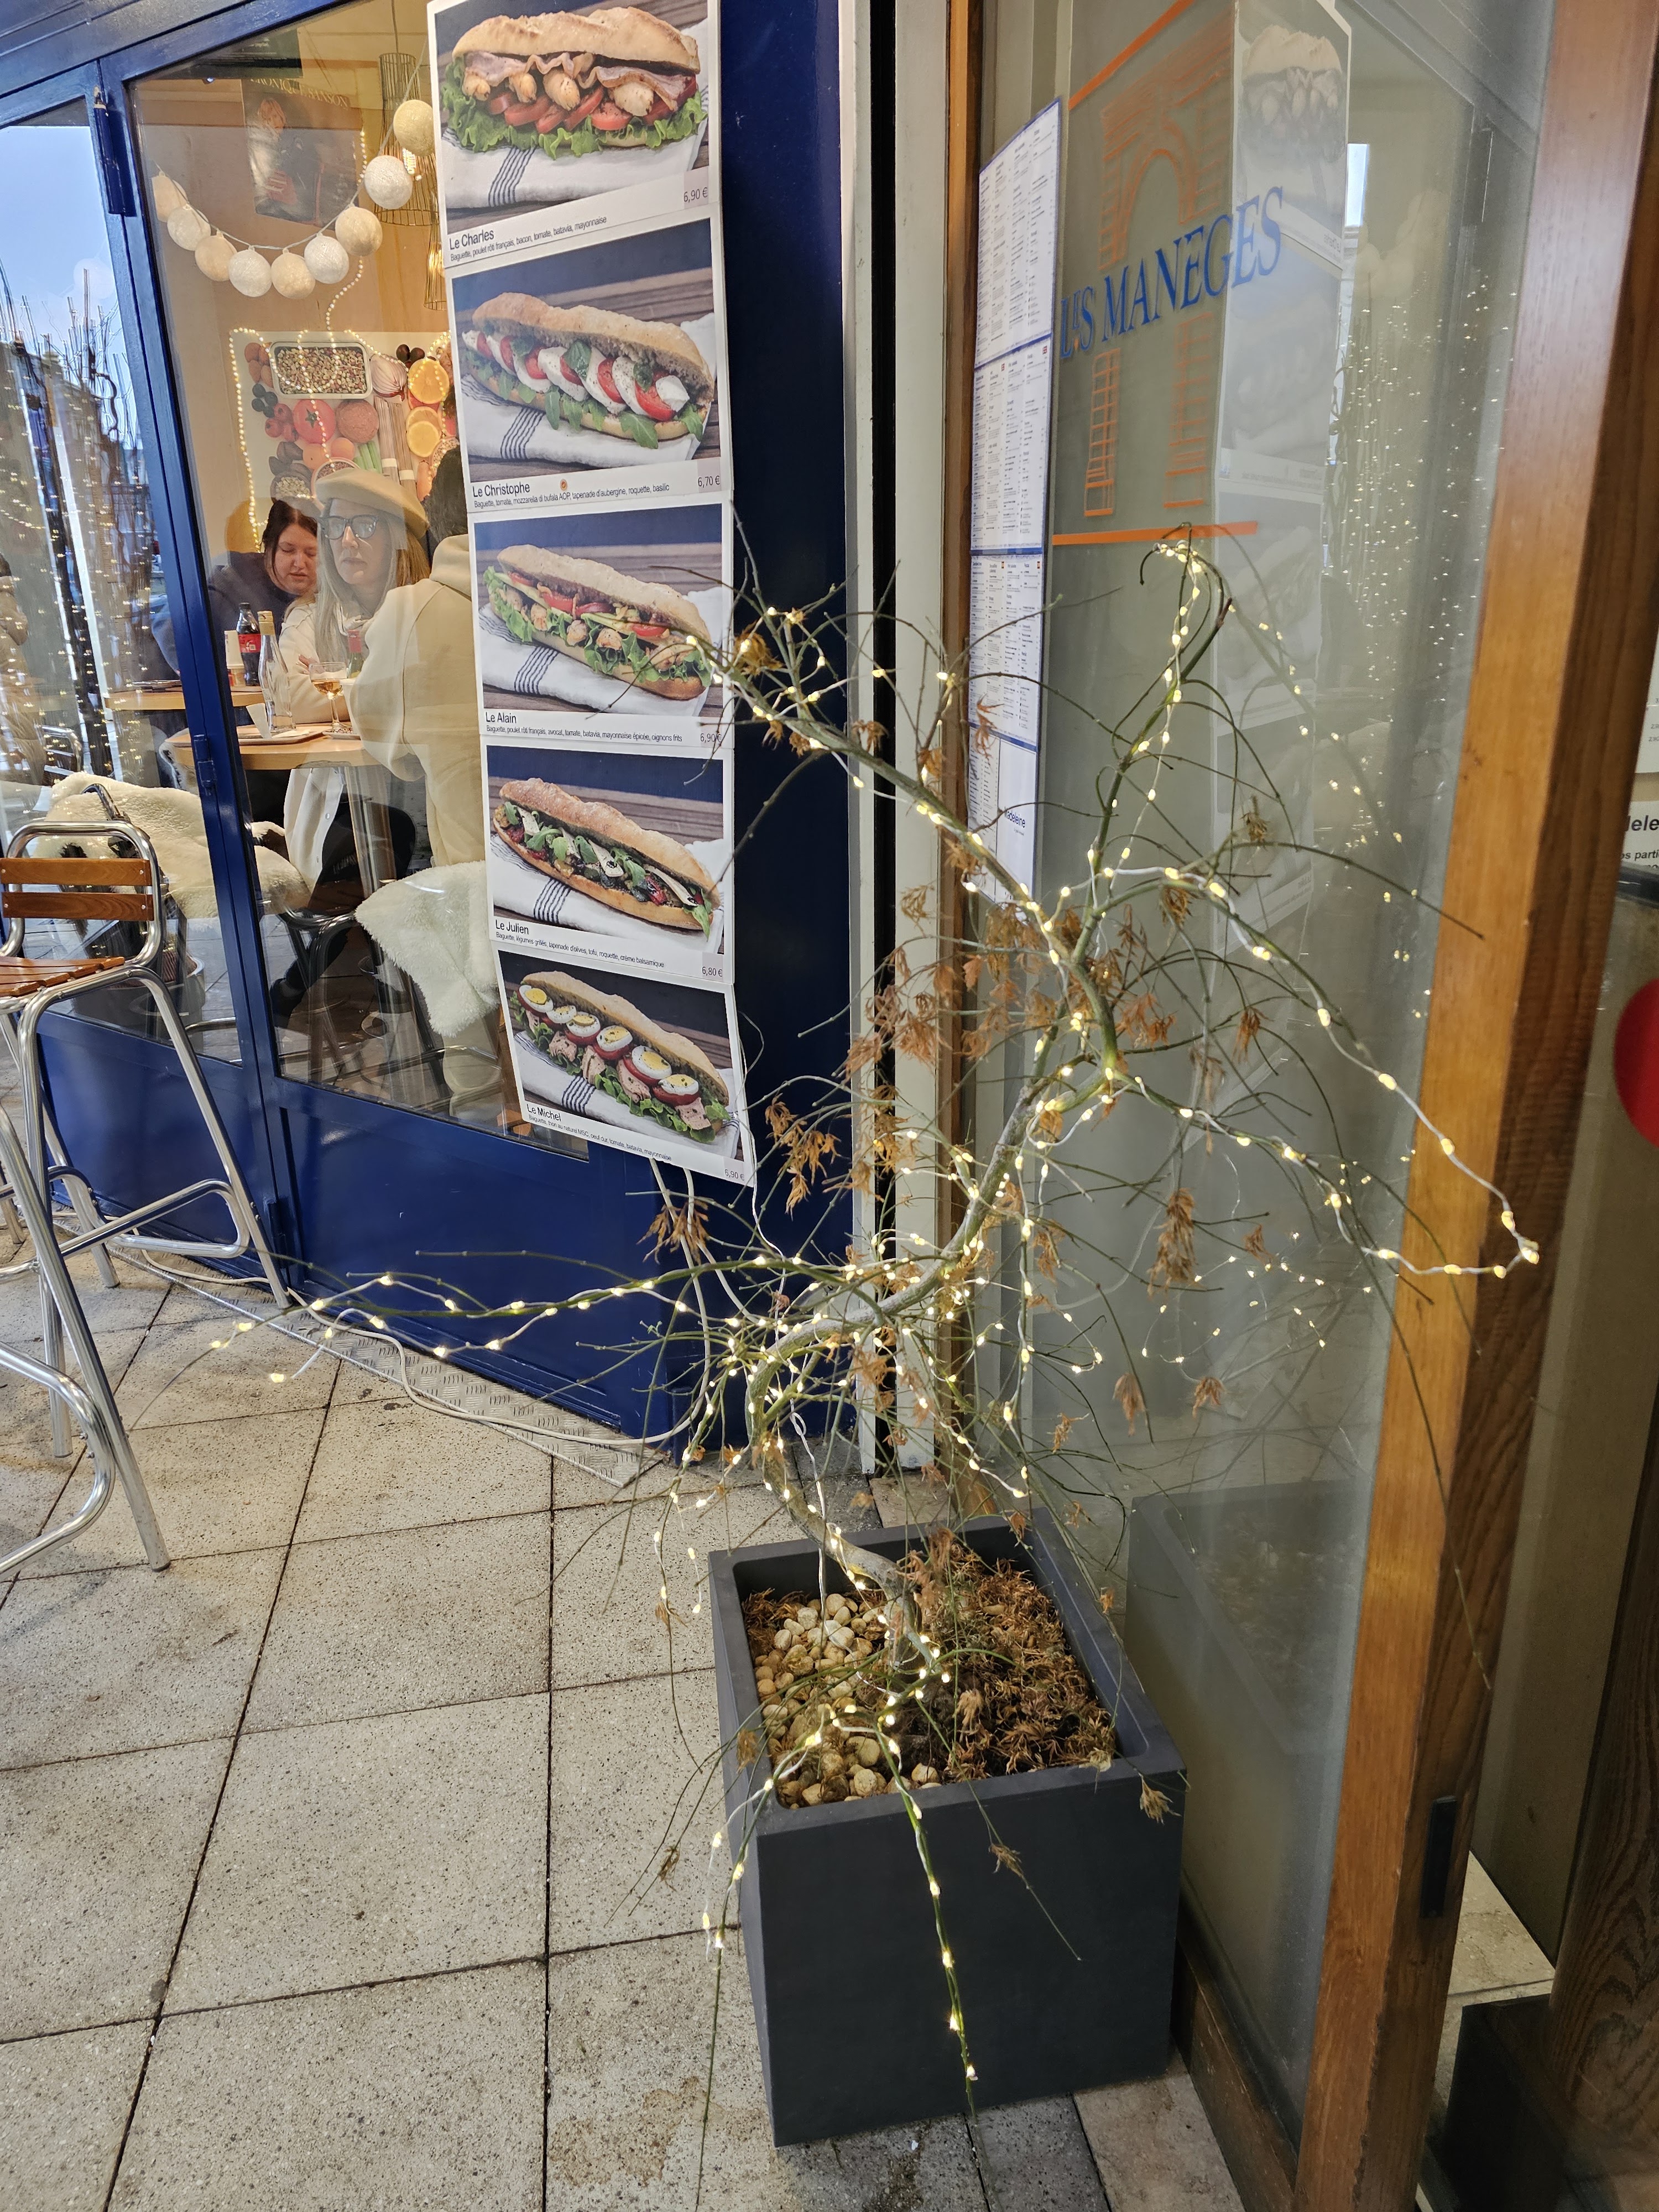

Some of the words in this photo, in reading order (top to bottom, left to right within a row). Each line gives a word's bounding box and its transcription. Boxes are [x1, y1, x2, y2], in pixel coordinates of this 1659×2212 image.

[308, 88, 349, 109] SANSON
[684, 189, 700, 203] 6,90
[702, 187, 708, 197] €
[450, 238, 460, 251] Le
[461, 229, 494, 247] Charles
[451, 251, 472, 262] Baguette,
[473, 247, 487, 257] poulet
[495, 239, 515, 250] français,
[516, 235, 533, 244] bacon,
[534, 229, 552, 241] tomate,
[554, 224, 573, 235] batavia,
[575, 216, 607, 230] mayonnaise
[1061, 286, 1094, 358] LES
[472, 486, 483, 497] Le
[484, 482, 530, 497] Christophe
[697, 476, 713, 488] 6,70
[714, 475, 720, 485] €
[474, 500, 495, 509] Baguette,
[513, 495, 538, 504] mozzarella
[572, 489, 596, 499] tapenade
[596, 488, 627, 498] d'aubergine,
[628, 486, 651, 495] roquette,
[653, 483, 670, 492] basilic
[486, 712, 495, 722] Le
[497, 712, 517, 723] Alain
[487, 725, 507, 733] Baguette,
[528, 727, 547, 736] français,
[547, 728, 564, 737] avocat,
[565, 729, 582, 738] tomate,
[602, 732, 632, 740] mayonnaise
[632, 733, 651, 741] épicée,
[651, 733, 672, 742] oignons
[700, 733, 716, 743] 6,90
[1635, 849, 1659, 861] parti
[495, 919, 504, 930] Le
[506, 921, 529, 935] Julien
[496, 932, 515, 942] Baguette,
[516, 935, 534, 945] légumes
[534, 938, 548, 948] grillés,
[549, 941, 569, 951] tapenade
[570, 945, 588, 955] d'olives,
[588, 948, 598, 957] tofu,
[599, 951, 620, 961] roquette,
[636, 957, 664, 968] balsamique
[702, 967, 717, 977] 6,80
[718, 969, 723, 977] €
[526, 1103, 536, 1114] Le
[537, 1107, 561, 1121] Michel
[564, 1125, 578, 1134] naturel
[644, 1149, 672, 1161] mayonnaise
[724, 1169, 738, 1179] 6,90
